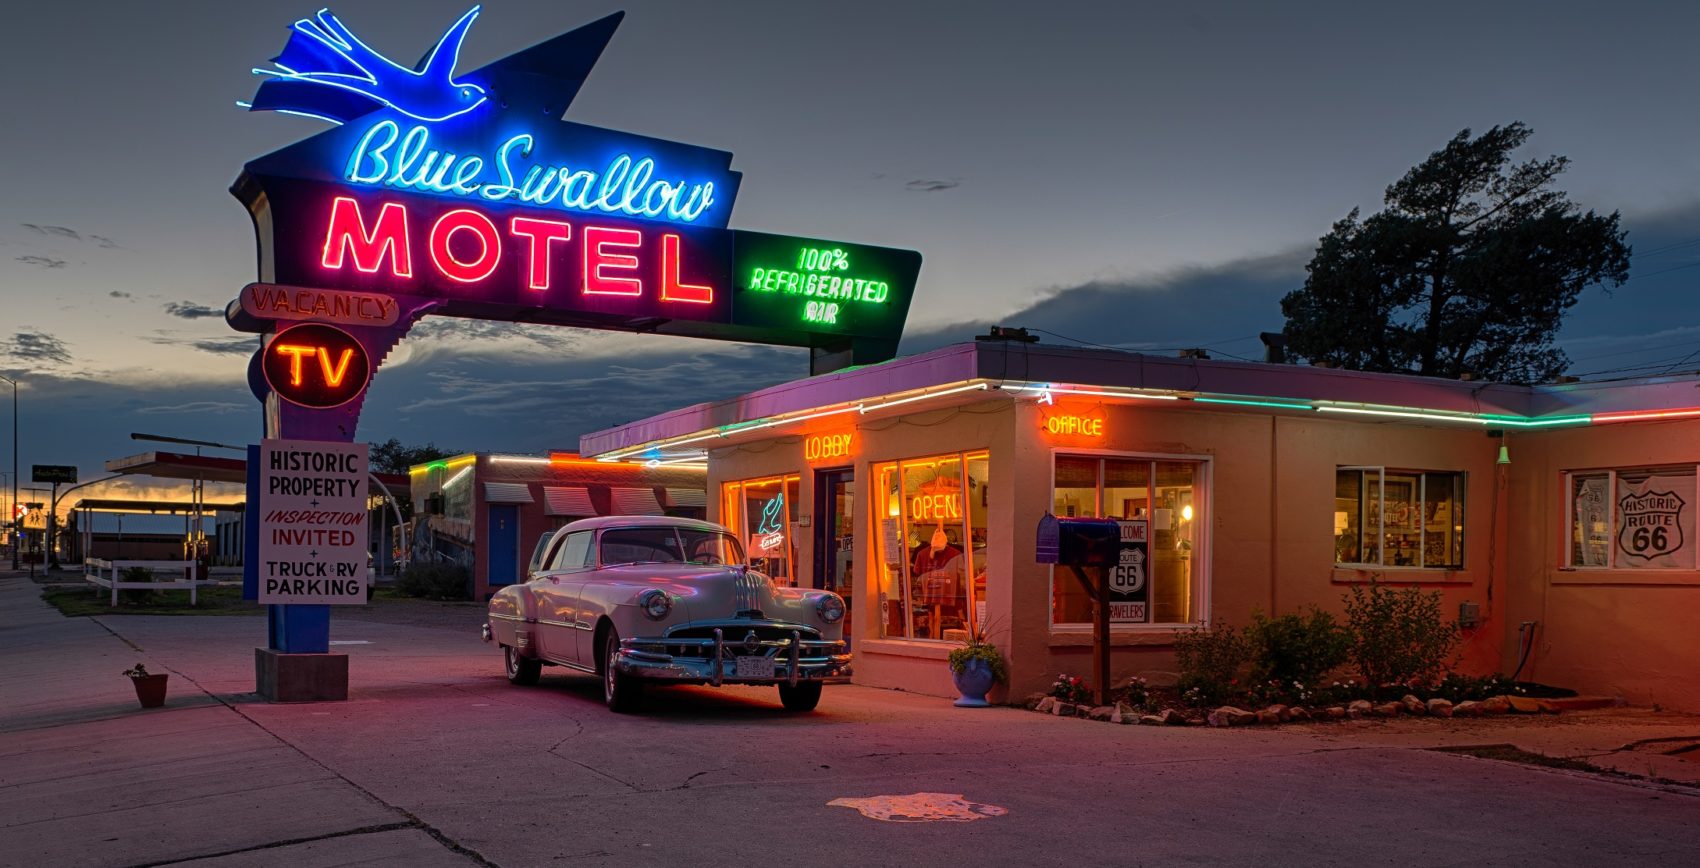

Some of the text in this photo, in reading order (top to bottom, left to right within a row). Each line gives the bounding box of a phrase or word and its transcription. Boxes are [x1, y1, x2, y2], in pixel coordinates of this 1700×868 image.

[344, 119, 714, 222] Blue Swallow
[321, 196, 713, 303] MOTEL
[797, 247, 849, 271] 100%
[749, 267, 888, 303] REFRIGERATED
[251, 287, 395, 320] VACANCY
[802, 300, 838, 324] AIR
[276, 344, 353, 387] TV
[1048, 416, 1103, 436] OFFICE
[805, 434, 852, 460] LOBBY
[270, 451, 358, 473] HISTORIC
[269, 476, 360, 497] PROPERTY
[912, 494, 958, 519] OPEN
[1625, 498, 1677, 512] HISTORIC
[265, 510, 365, 525] INSPECTION
[1628, 515, 1673, 527] ROUTE
[272, 529, 355, 546] INVITED
[1120, 526, 1144, 539] LCOME
[1632, 526, 1668, 552] 66
[266, 561, 358, 577] TRUCK & RV
[1116, 566, 1136, 586] 66
[266, 579, 360, 595] PARKING
[1110, 605, 1143, 618] RAVELERS
